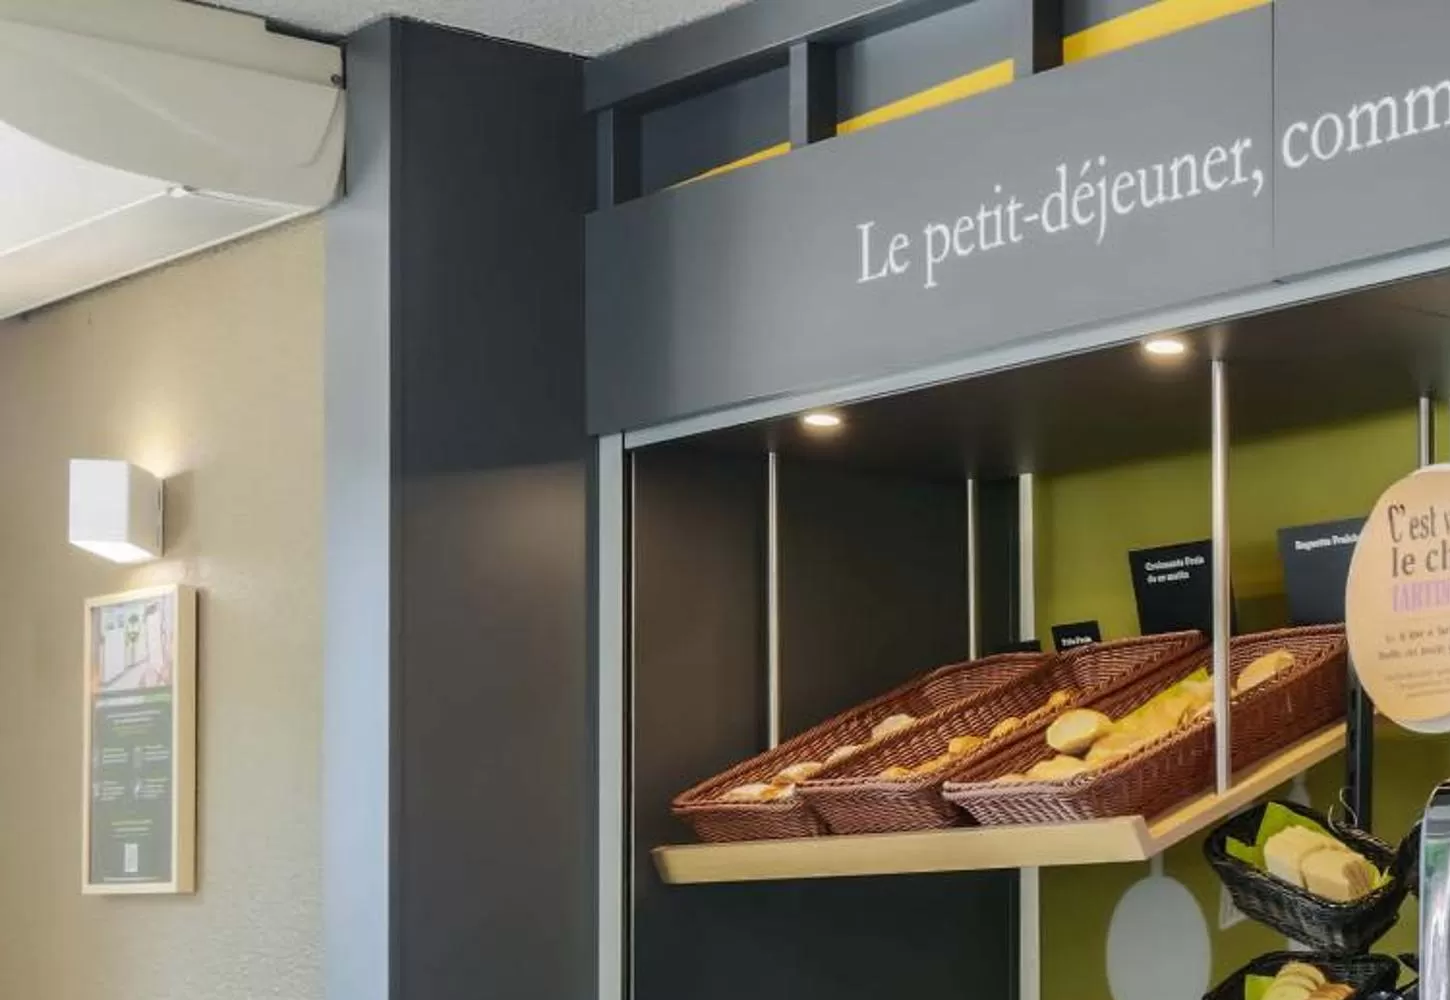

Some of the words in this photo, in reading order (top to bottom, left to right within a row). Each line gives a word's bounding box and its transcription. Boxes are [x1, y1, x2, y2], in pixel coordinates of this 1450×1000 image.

[857, 220, 912, 284] Le
[923, 137, 1265, 289] petit-déjeuner,
[1391, 547, 1416, 578] le
